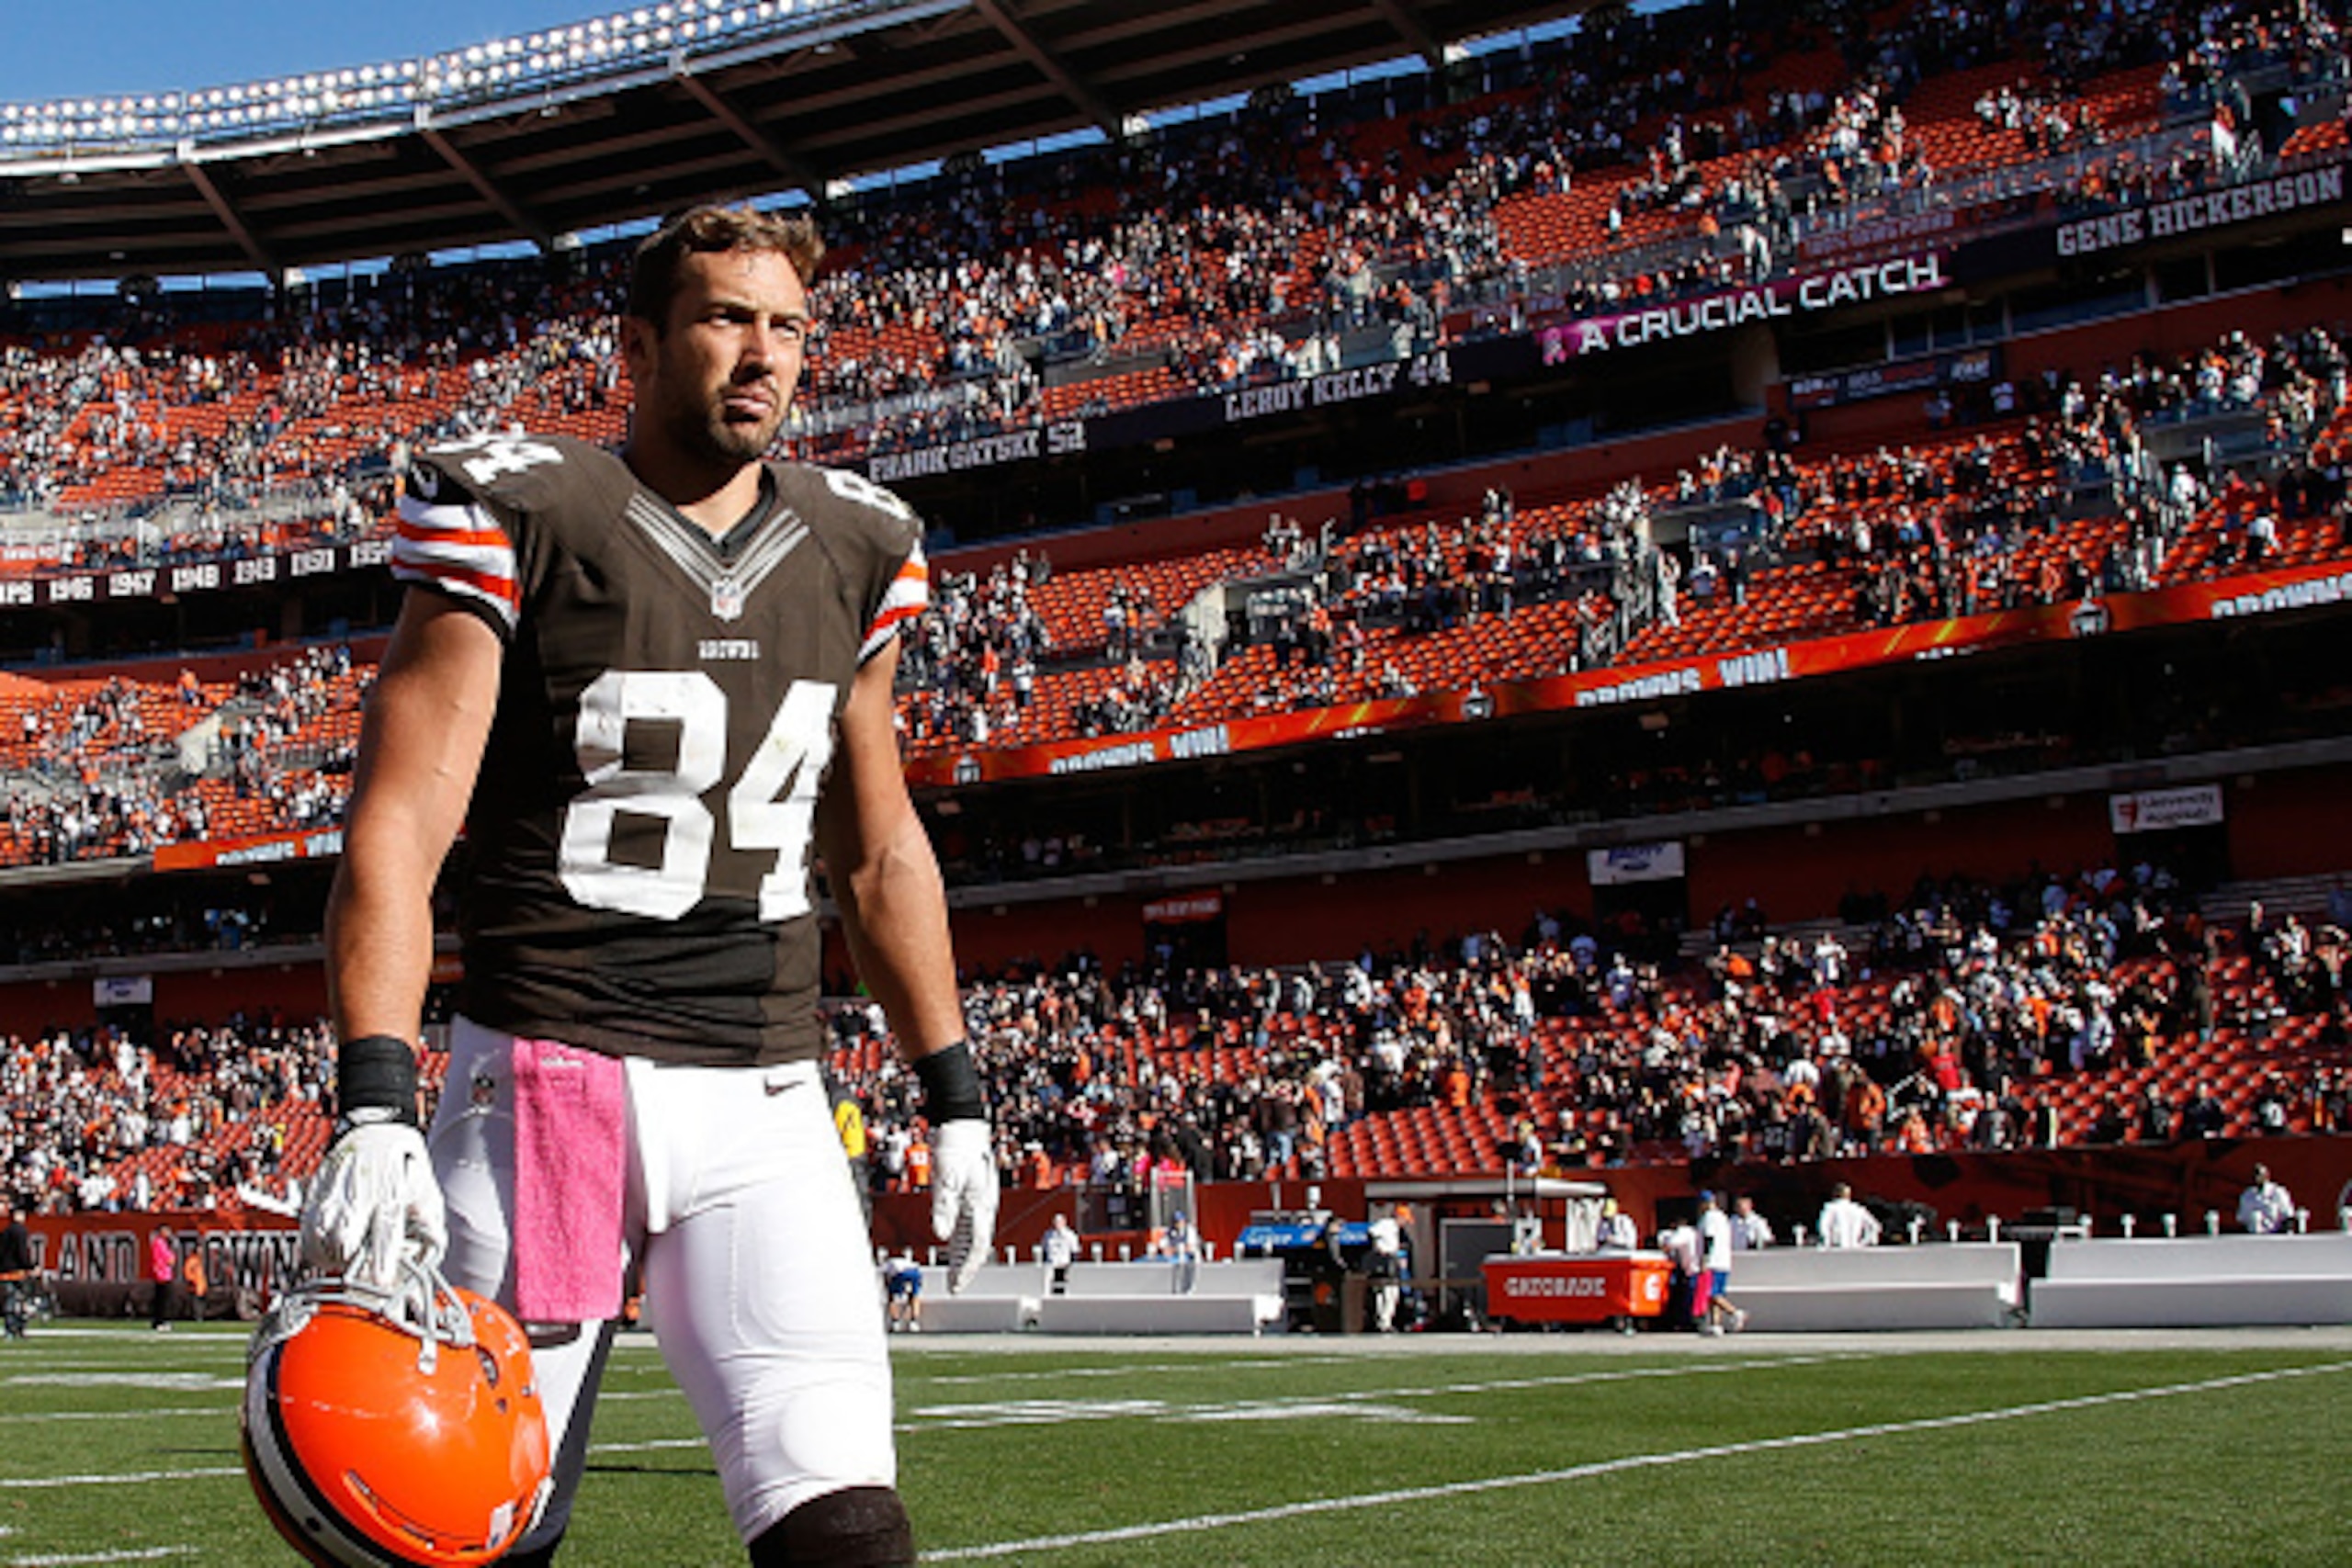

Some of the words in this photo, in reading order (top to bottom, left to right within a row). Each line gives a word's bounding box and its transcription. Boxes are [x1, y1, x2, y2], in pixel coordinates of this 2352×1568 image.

[2056, 209, 2144, 256] GENE
[2149, 164, 2343, 237] HICKERSON
[1578, 321, 1610, 355] A
[1617, 288, 1792, 347] CRUCIAL
[1800, 253, 1939, 310] CATCH
[1224, 378, 1309, 423] LEROY
[1312, 361, 1400, 406] KELLY
[1408, 350, 1452, 387] 44
[557, 671, 838, 924] 84
[1504, 1276, 1607, 1297] GATORADE
